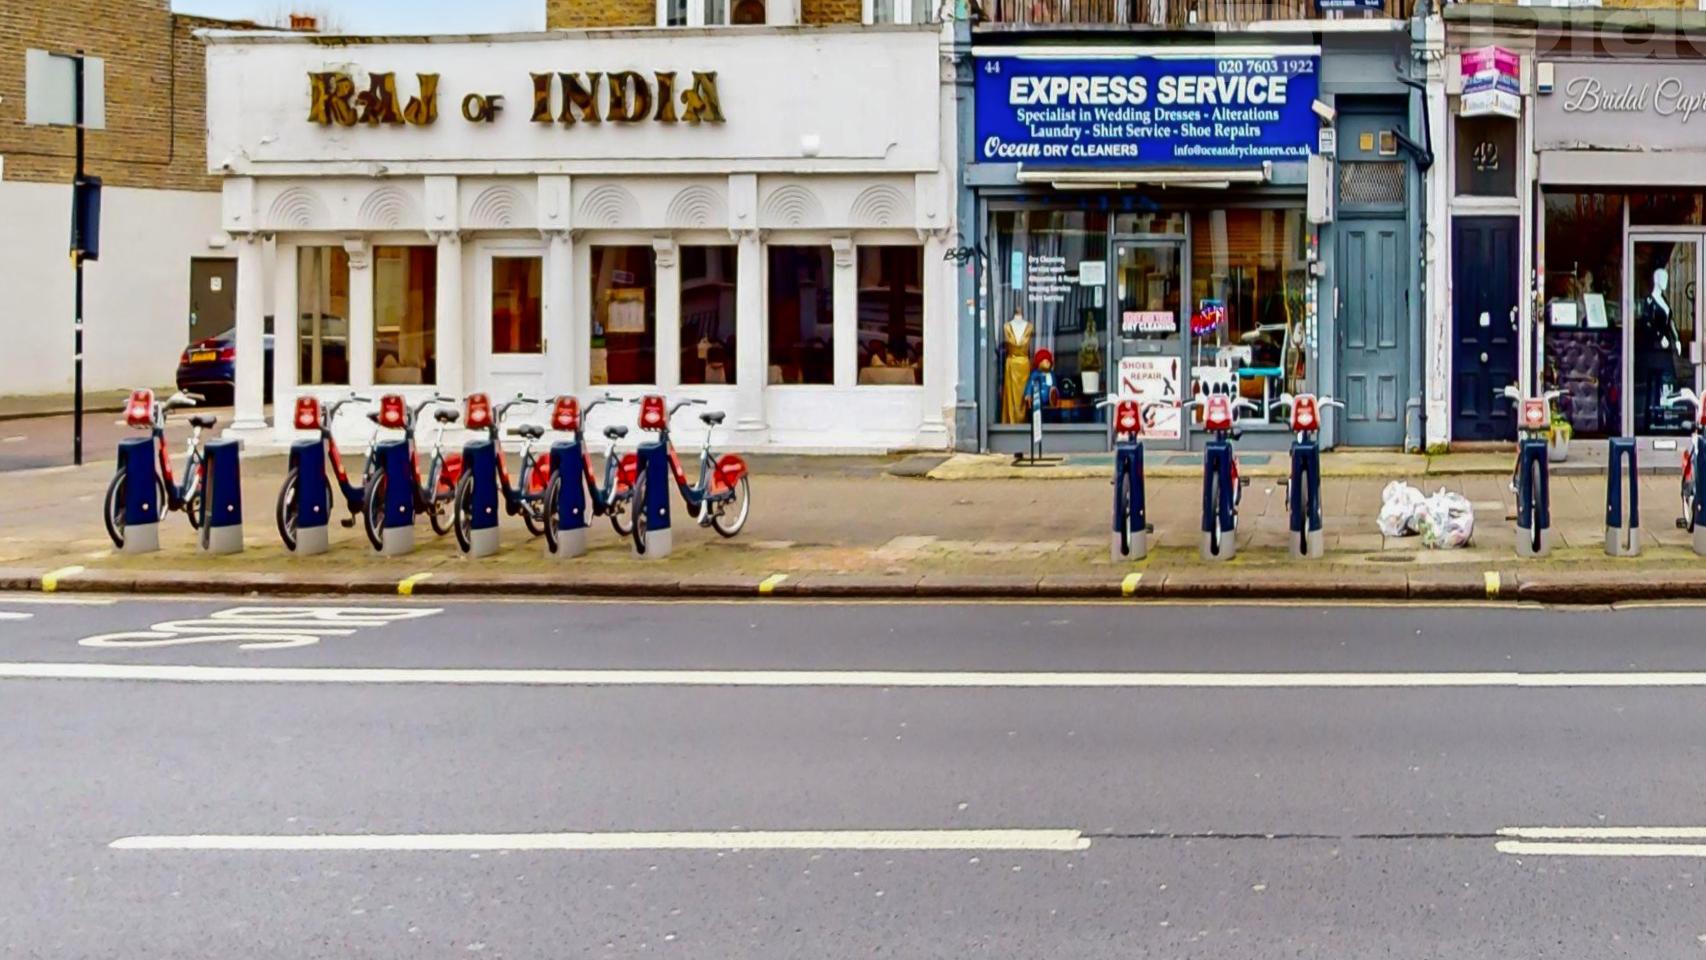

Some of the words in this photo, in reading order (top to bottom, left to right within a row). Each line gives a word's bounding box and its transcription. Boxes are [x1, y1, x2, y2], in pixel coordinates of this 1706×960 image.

[984, 60, 1001, 74] 44
[1218, 60, 1244, 73] 020
[1246, 60, 1279, 73] 7603
[1281, 60, 1314, 73] 1922
[306, 70, 440, 127] RAJ
[460, 93, 506, 123] OF
[529, 70, 728, 127] INDIA
[1009, 75, 1148, 105] EXPRESS
[1157, 75, 1287, 105] SERVICE
[1564, 76, 1649, 113] Bridal
[1017, 107, 1077, 124] Specialist
[1079, 108, 1092, 121] in
[1094, 107, 1151, 125] Wedding
[1154, 108, 1202, 121] Dresses
[1212, 107, 1280, 121] Alterations
[1030, 123, 1082, 141] Laundry
[1092, 123, 1124, 137] Shirt
[1126, 123, 1171, 137] Service
[1180, 123, 1211, 137] Shoe
[1213, 123, 1261, 140] Repairs
[983, 136, 1041, 158] Ocean
[1043, 144, 1069, 156] DRY
[1071, 143, 1139, 157] CLEANERS
[1174, 143, 1312, 159] info@oceandrycleaners.co.uk
[1472, 140, 1499, 171] 42
[1121, 361, 1154, 370] SHOES
[1130, 372, 1162, 380] REPAIR
